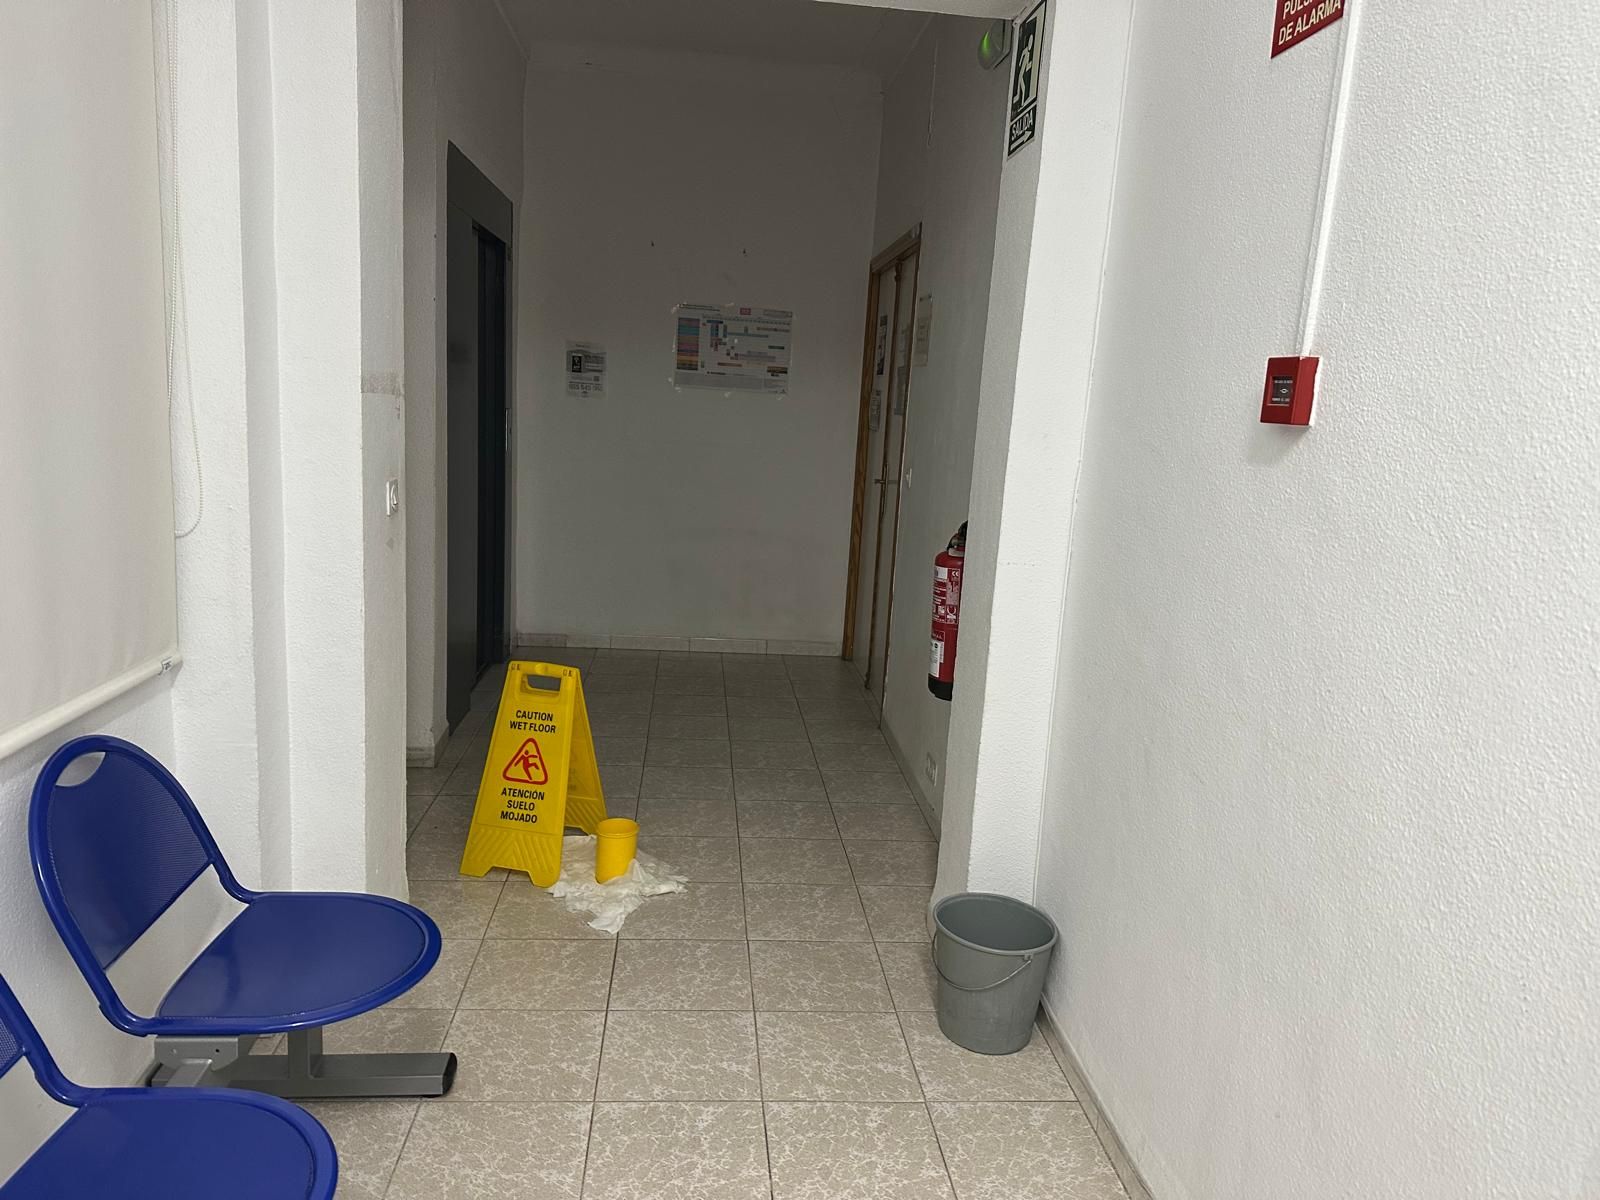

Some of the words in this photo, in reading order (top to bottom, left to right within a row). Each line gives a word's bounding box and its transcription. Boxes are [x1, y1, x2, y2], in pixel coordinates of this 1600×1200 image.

[1278, 21, 1294, 46] DE
[1293, 0, 1341, 37] ALARMA
[1011, 110, 1033, 142] SALIDA
[516, 709, 554, 722] CAUTION
[509, 720, 528, 731] WET
[529, 722, 556, 734] FLOOR
[501, 787, 545, 801] ATENCIÓN
[506, 799, 536, 811] SUELO
[500, 810, 538, 824] MOJADO
